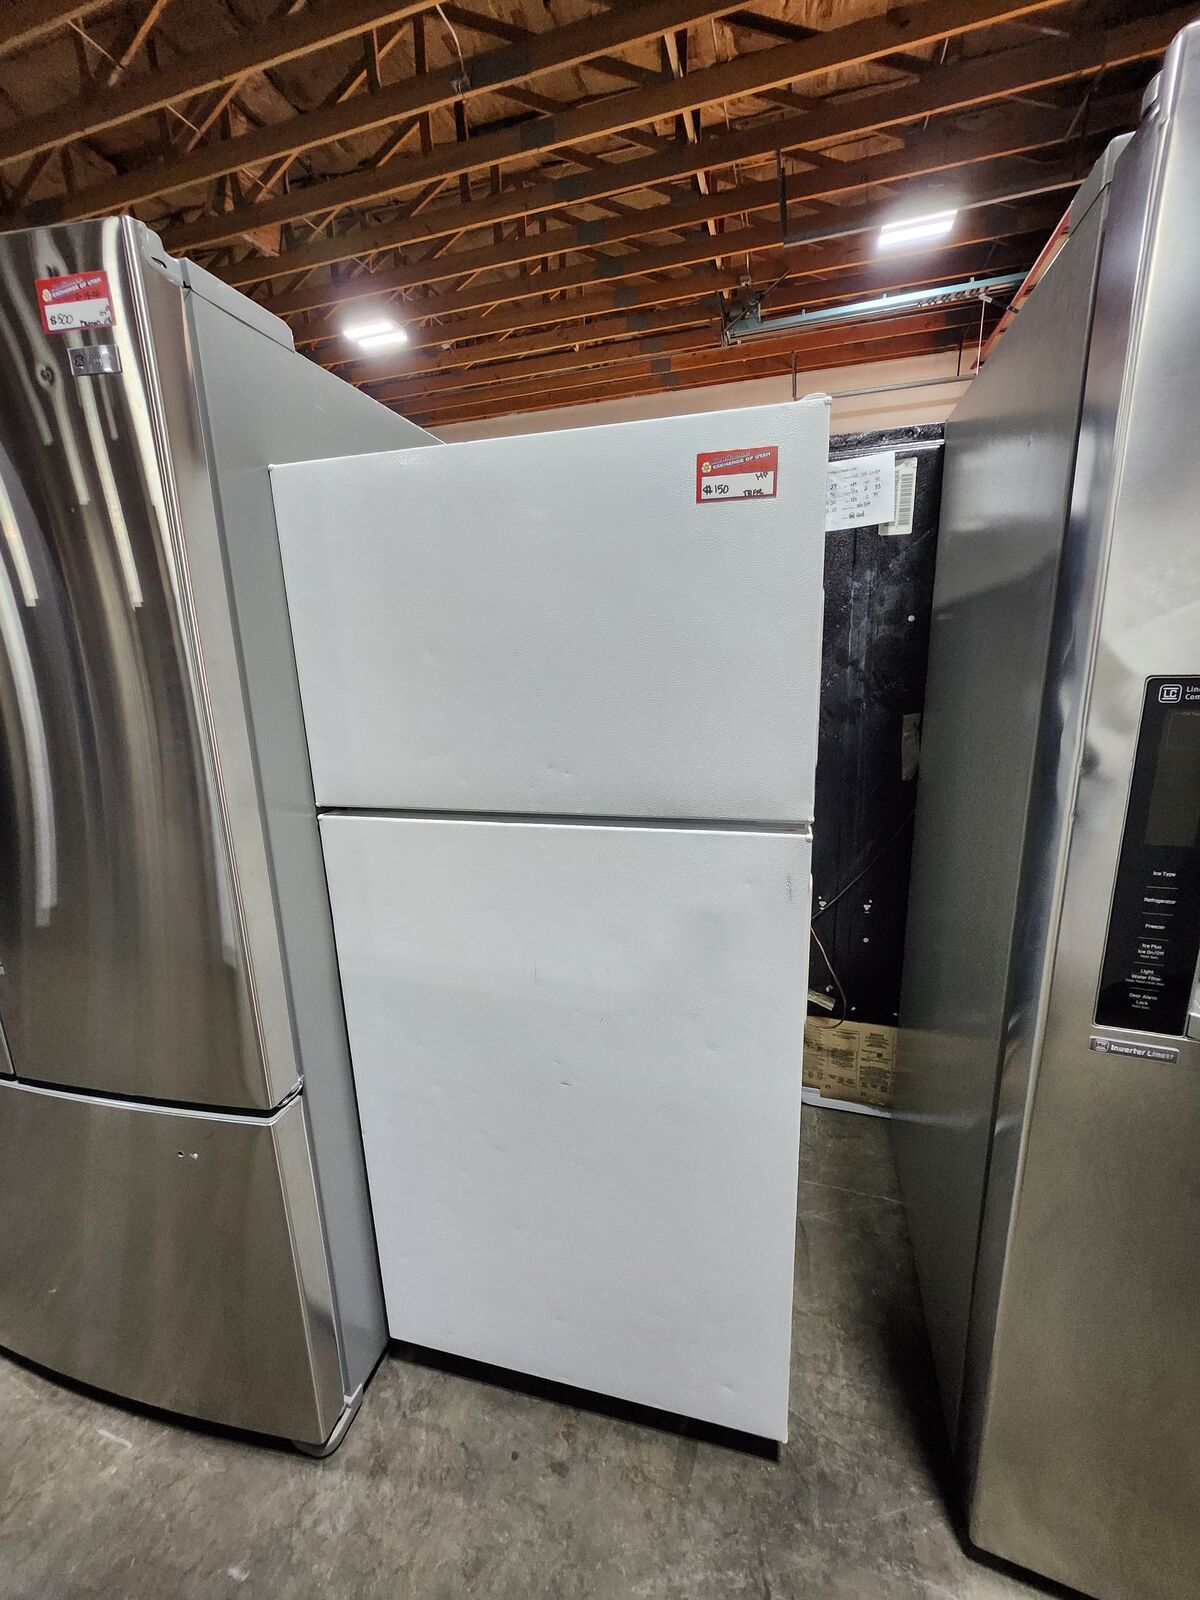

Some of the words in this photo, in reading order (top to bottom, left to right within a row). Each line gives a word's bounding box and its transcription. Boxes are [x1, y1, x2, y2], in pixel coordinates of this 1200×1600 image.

[50, 313, 74, 325] $500
[712, 458, 745, 470] EXCHANGE
[755, 451, 771, 459] UTAH
[702, 484, 730, 495] $150
[1110, 1044, 1146, 1055] Inverter
